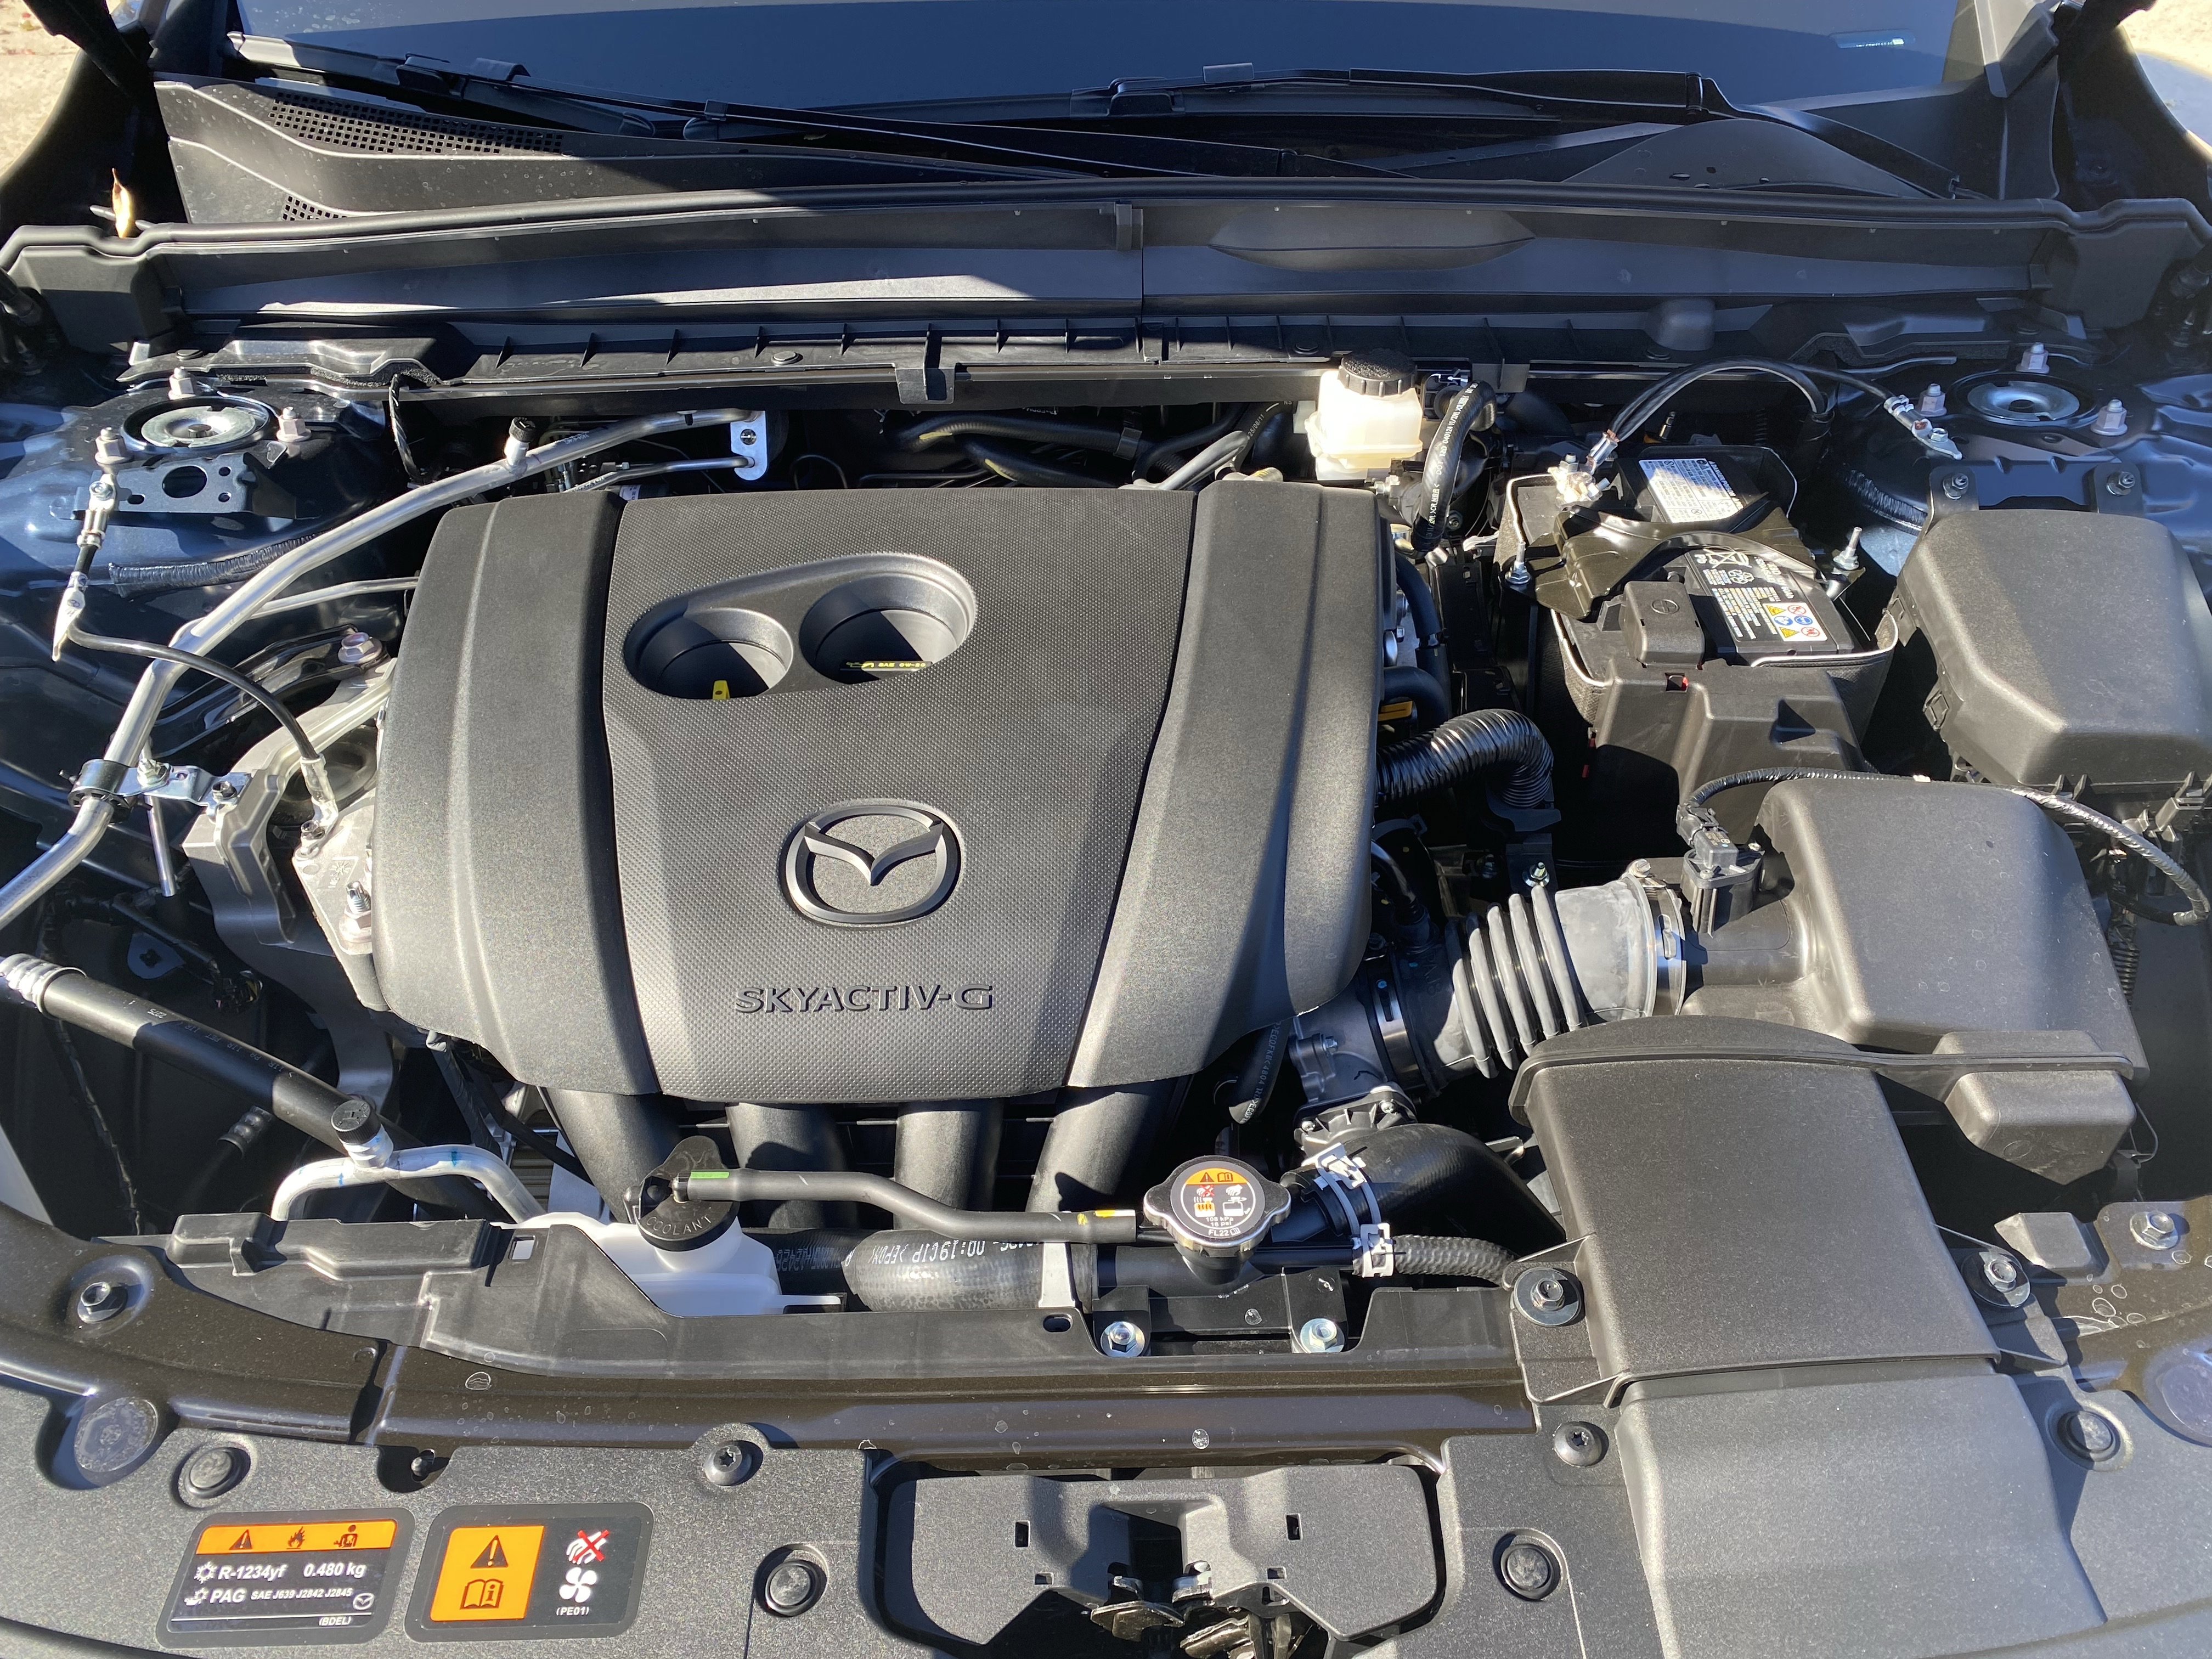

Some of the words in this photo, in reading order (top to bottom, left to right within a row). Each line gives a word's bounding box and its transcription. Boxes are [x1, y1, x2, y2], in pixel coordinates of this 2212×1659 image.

[1248, 413, 1265, 437] 25/06/11
[1442, 424, 1453, 444] 040124
[1694, 554, 1706, 564] Pb
[735, 984, 993, 1014] SKYACTIV-G
[646, 1214, 712, 1236] COOLANT
[217, 1564, 288, 1582] R-1234yf
[303, 1562, 344, 1578] 0.480
[345, 1562, 367, 1578] kg
[209, 1588, 246, 1604] PAG
[250, 1590, 273, 1600] SAE
[272, 1589, 295, 1600] J639
[296, 1588, 324, 1599] J2842
[324, 1588, 353, 1598] J2845
[556, 1605, 590, 1617] (PE01)
[318, 1616, 352, 1627] (BDEL)
